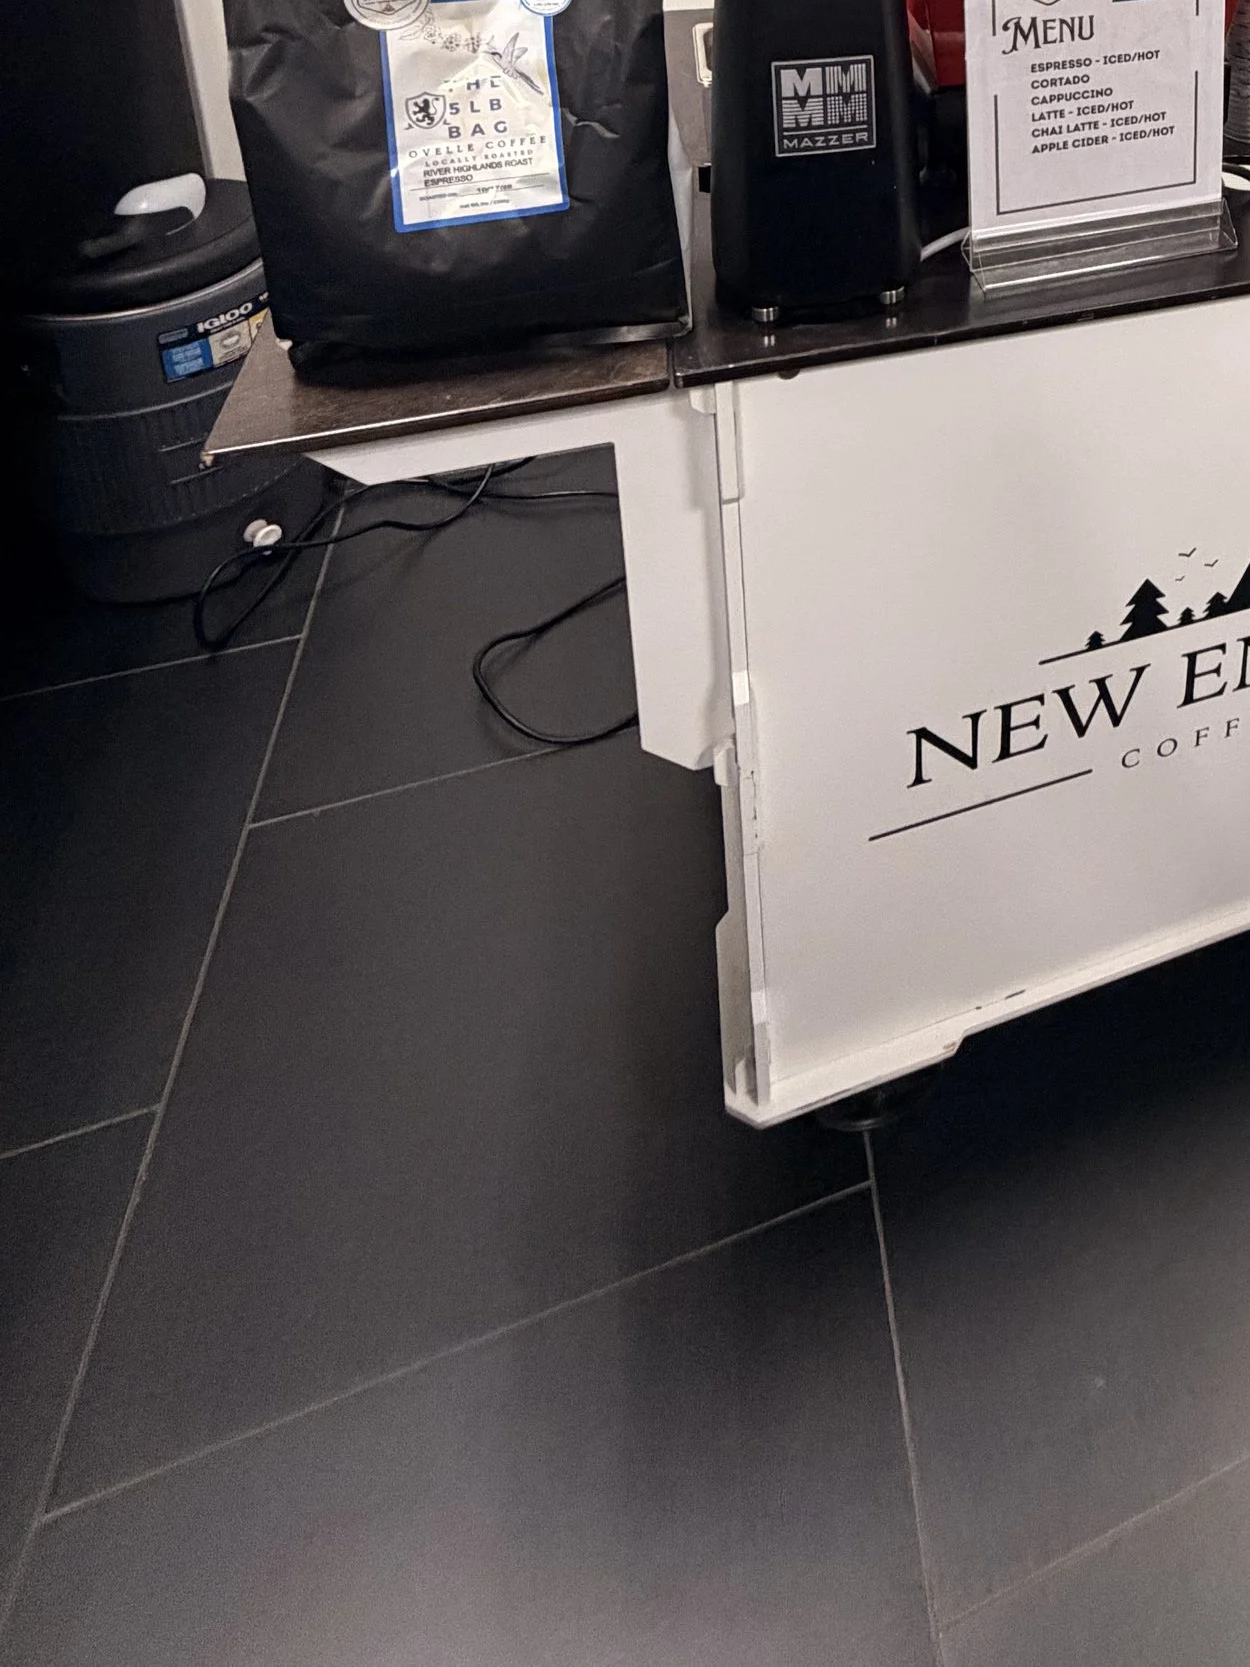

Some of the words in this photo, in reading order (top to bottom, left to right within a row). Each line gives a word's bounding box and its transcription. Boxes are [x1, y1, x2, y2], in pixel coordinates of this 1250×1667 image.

[1001, 14, 1095, 56] MENU
[1030, 57, 1092, 74] ESPRESSO
[1103, 50, 1160, 66] ICED/HOT
[1030, 74, 1090, 90] CORTADO
[1030, 87, 1113, 106] CAPPUCCINO
[1031, 109, 1066, 123] LATTE
[1076, 100, 1134, 117] ICED/HOT
[448, 120, 509, 140] BAG
[1031, 125, 1063, 138] CHAI
[1066, 120, 1100, 134] LATTE
[1110, 111, 1167, 128] ICED/HOT
[408, 143, 475, 159] OVELLE
[484, 135, 548, 150] COFFEE
[783, 132, 868, 150] MAZZER
[1031, 140, 1069, 154] APPLE
[1071, 134, 1109, 149] CIDER
[1119, 125, 1175, 142] ICED/HOT
[423, 166, 452, 178] RIVER
[452, 160, 503, 174] HIGHLANDS
[504, 157, 534, 168] ROAST
[423, 175, 474, 188] ESPRESSO
[197, 301, 254, 333] IGLOO
[905, 662, 1152, 789] NEW
